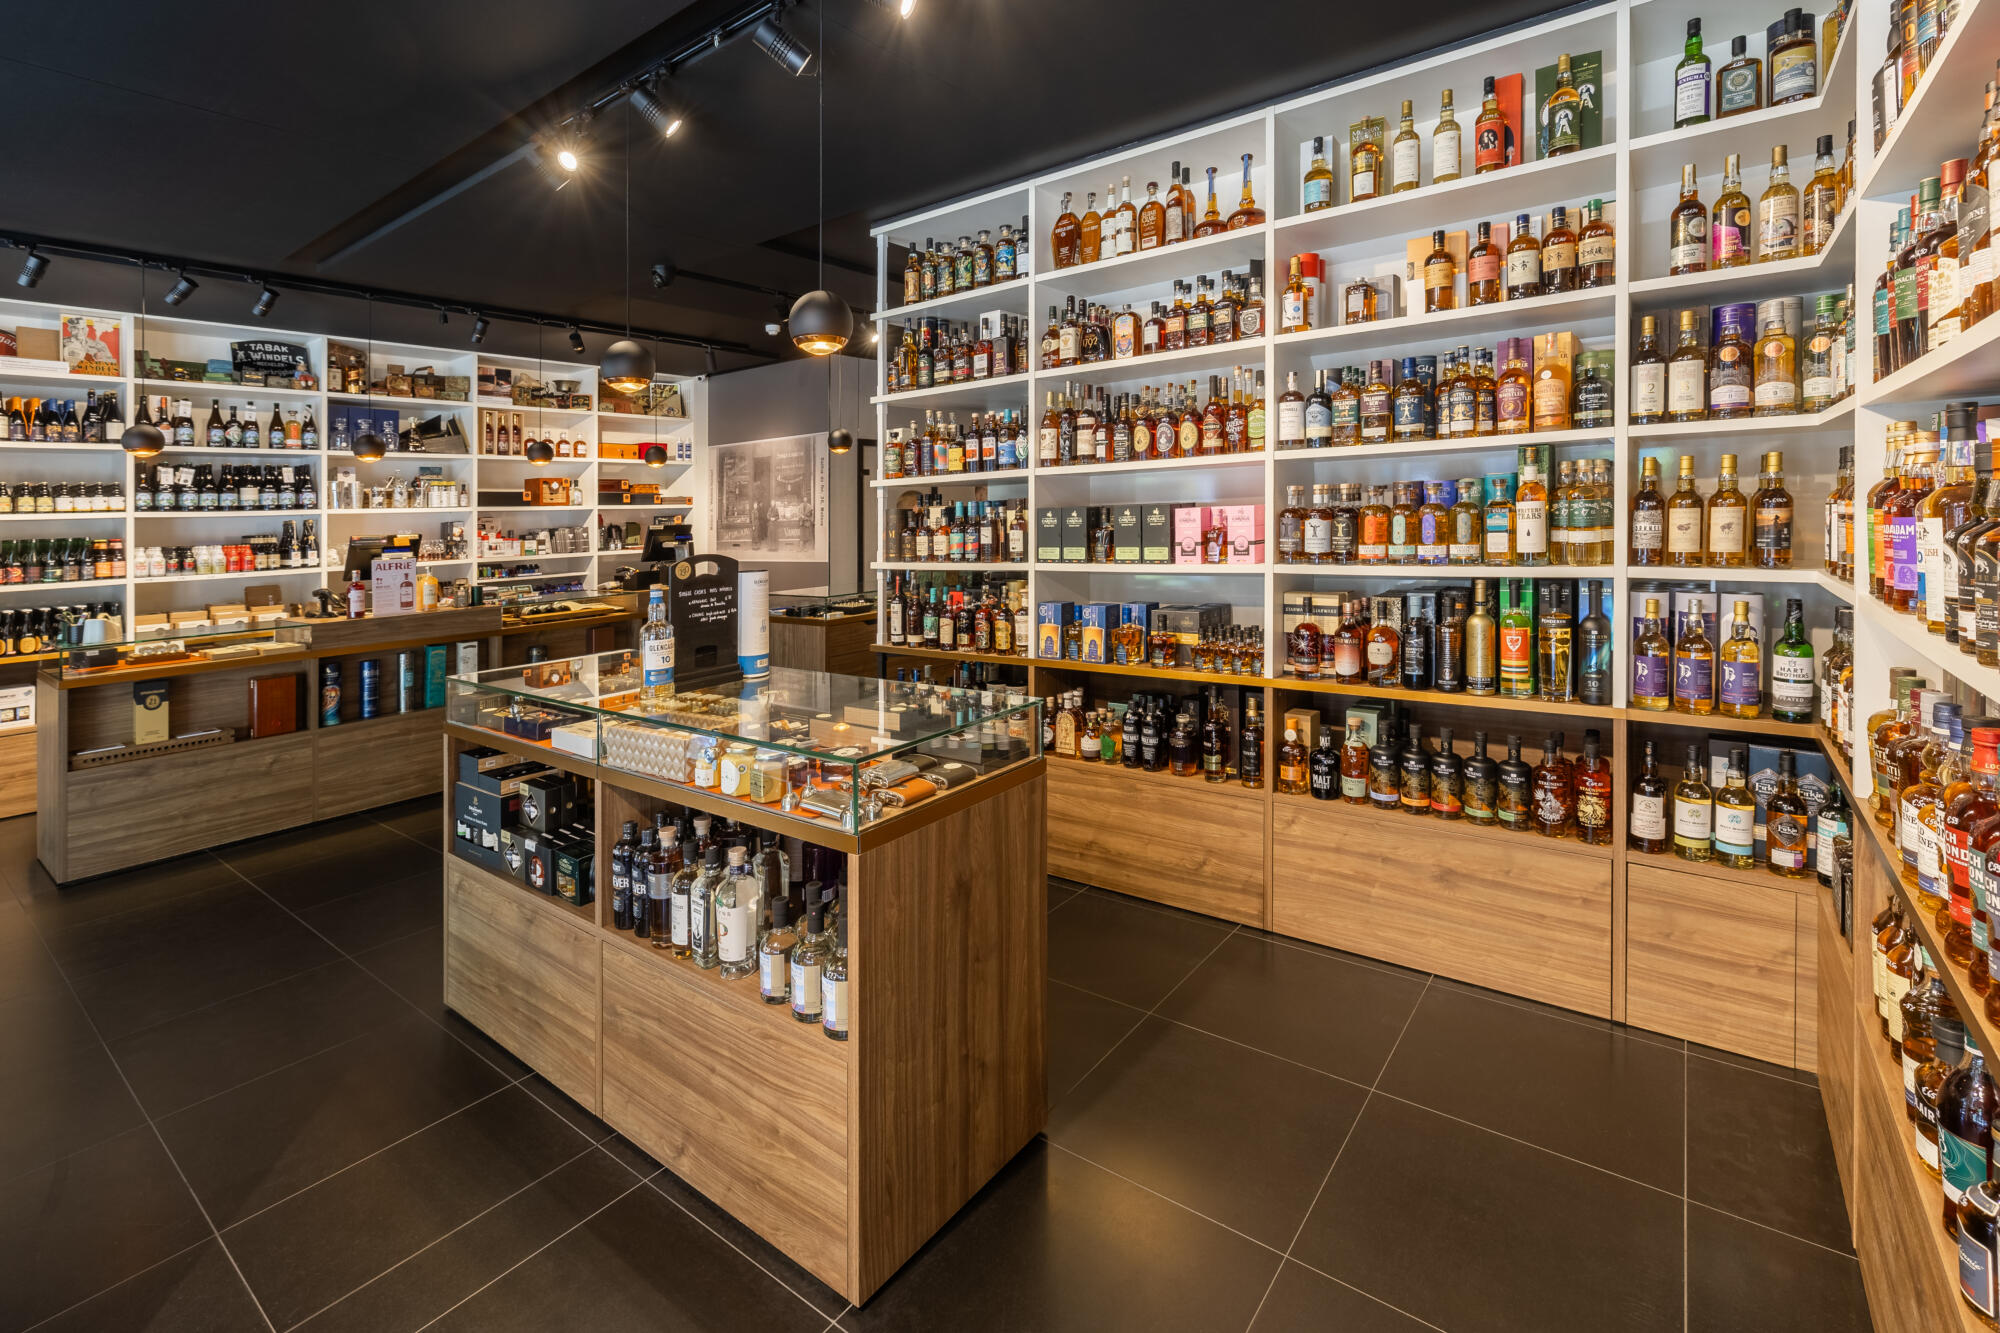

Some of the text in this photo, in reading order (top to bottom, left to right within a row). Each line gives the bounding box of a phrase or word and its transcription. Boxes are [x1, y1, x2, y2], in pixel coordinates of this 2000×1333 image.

[249, 343, 289, 353] TABAK
[248, 351, 305, 365] WINDELS
[661, 655, 671, 664] 10
[1776, 670, 1809, 678] BROTHERS
[1312, 774, 1331, 784] MALT
[1945, 831, 1957, 844] CH
[1915, 1096, 1936, 1123] LAIR
